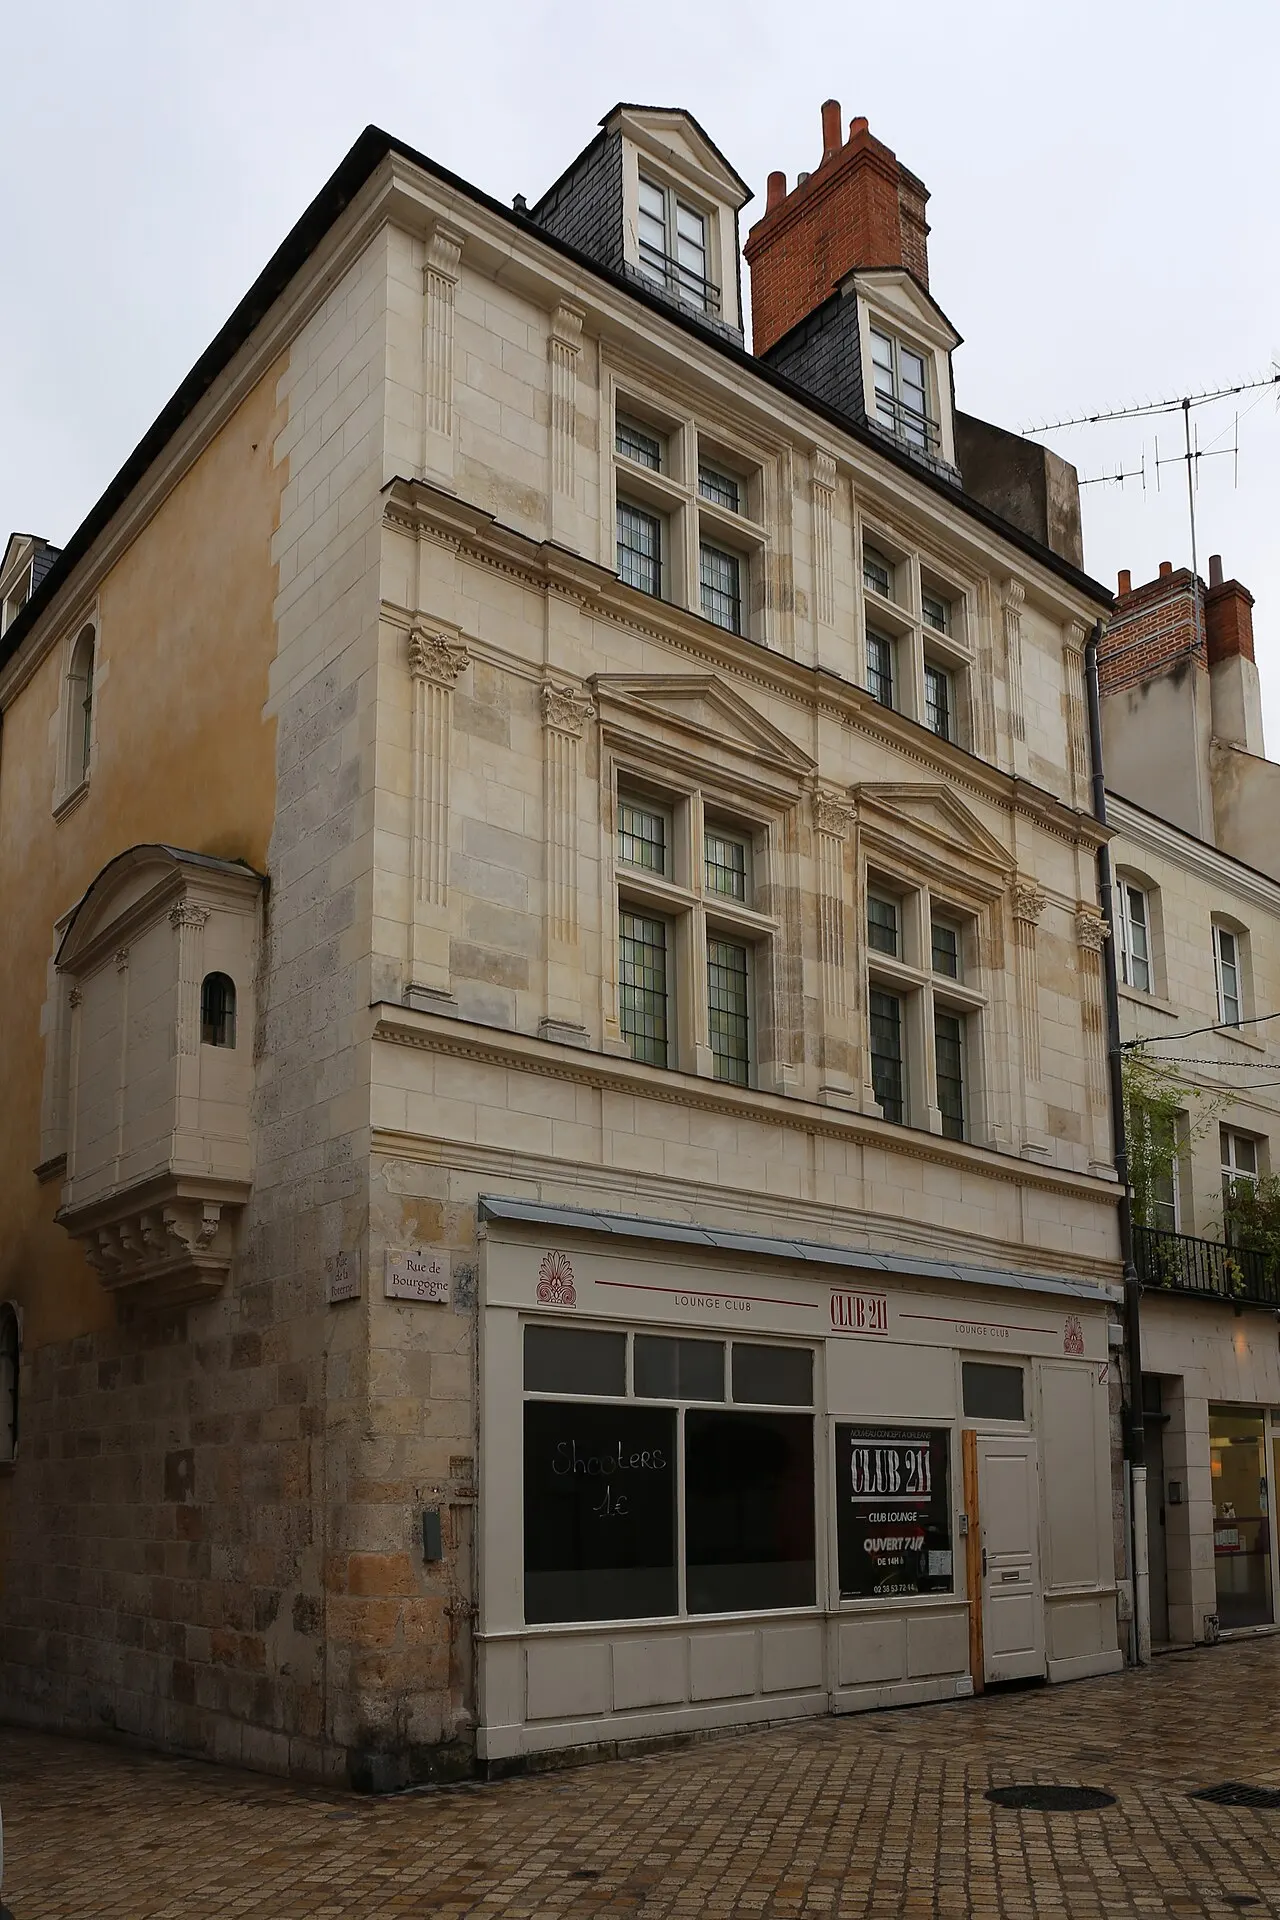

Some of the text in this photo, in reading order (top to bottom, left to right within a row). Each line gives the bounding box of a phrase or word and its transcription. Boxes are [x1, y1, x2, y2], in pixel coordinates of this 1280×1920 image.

[406, 1260, 441, 1273] Rue de
[392, 1274, 449, 1296] Bourgogne
[674, 1296, 751, 1311] LOUNGE CLUB
[830, 1294, 888, 1329] CLUB 211
[955, 1325, 1009, 1338] LOUNGE CLUB
[851, 1448, 932, 1493] CLUB 211
[868, 1511, 918, 1523] CLUB LOUNGE
[863, 1537, 904, 1552] OUVERT
[877, 1557, 887, 1566] DE
